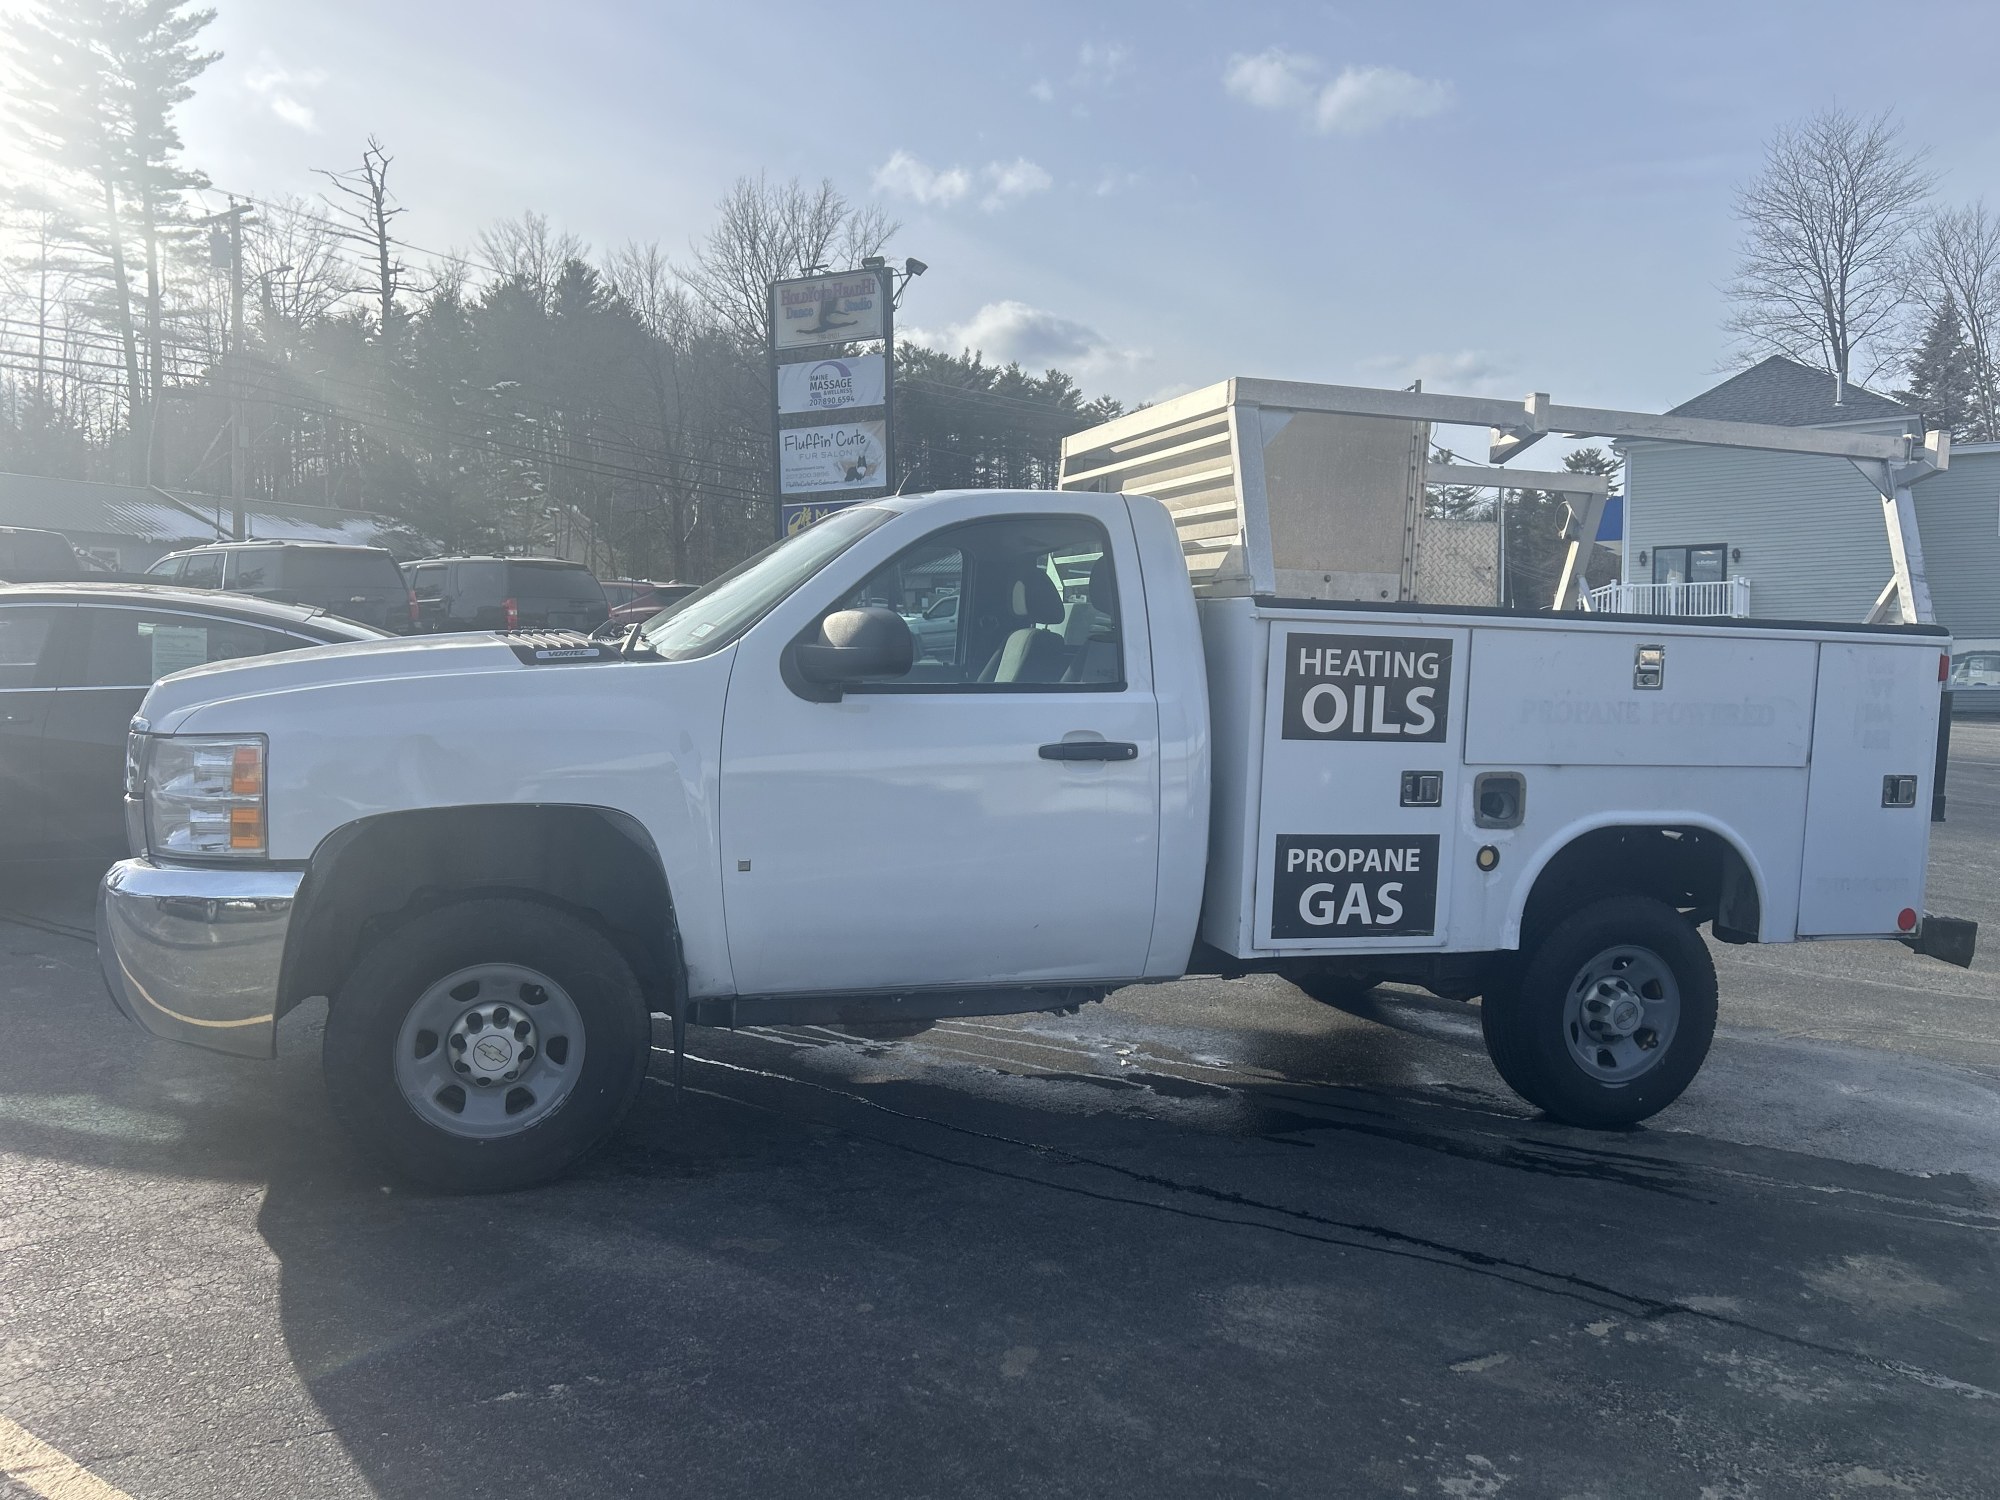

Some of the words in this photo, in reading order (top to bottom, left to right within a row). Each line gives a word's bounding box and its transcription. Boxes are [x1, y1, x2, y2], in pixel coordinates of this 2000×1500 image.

[810, 378, 852, 391] MASSAGE
[785, 433, 834, 450] Fluffin'
[836, 429, 866, 446] Cute
[799, 451, 818, 460] FUR
[821, 449, 853, 458] SALON
[1299, 647, 1439, 680] HEATING
[1302, 683, 1436, 735] OILS
[1287, 848, 1420, 873] PROPANE
[1299, 881, 1403, 925] GAS
